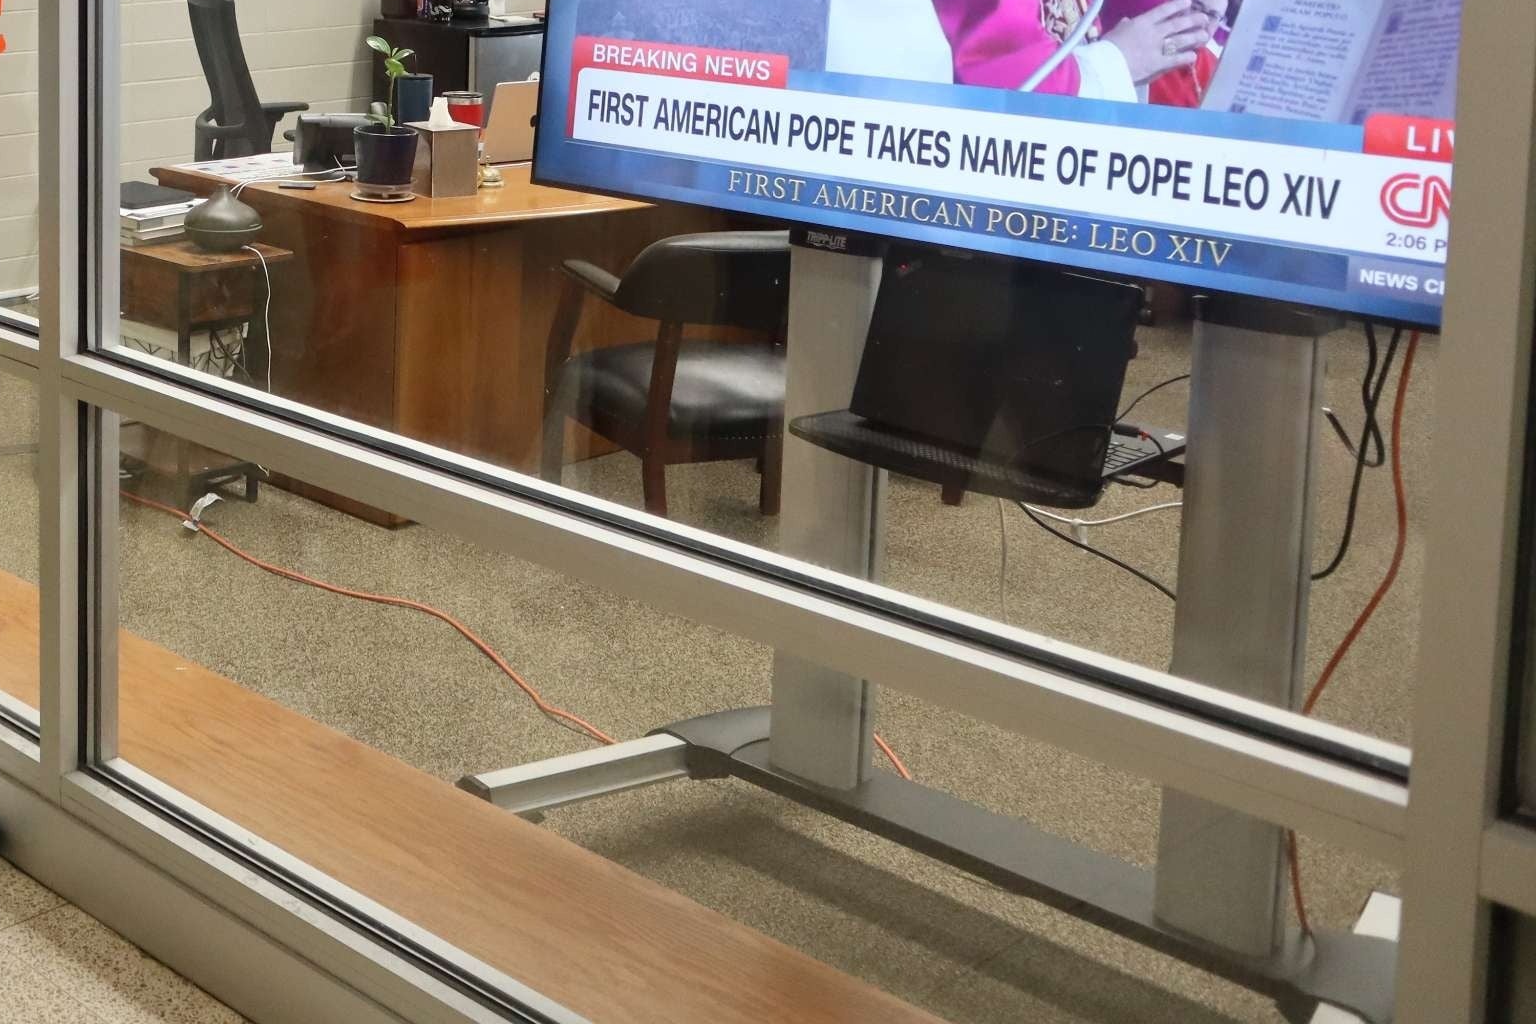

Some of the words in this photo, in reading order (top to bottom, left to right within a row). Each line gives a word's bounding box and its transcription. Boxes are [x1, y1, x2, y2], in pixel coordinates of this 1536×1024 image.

[592, 43, 698, 74] BREAKING
[704, 54, 771, 81] NEWS
[587, 88, 649, 128] FIRST
[653, 96, 781, 145] AMERICAN
[787, 113, 855, 156] POPE
[863, 121, 952, 169] TAKES
[960, 133, 1048, 182] NAME
[1056, 145, 1099, 188] OF
[1106, 151, 1193, 201] POPE
[1202, 163, 1270, 211] LEO
[1279, 172, 1342, 220] XIV
[727, 168, 807, 203] FIRST
[811, 182, 979, 229] AMERICAN
[986, 206, 1079, 245] POPE:
[1088, 222, 1158, 257] LEO
[1166, 233, 1234, 268] XIV
[1385, 231, 1427, 251] 2:06
[1359, 268, 1418, 292] NEWS
